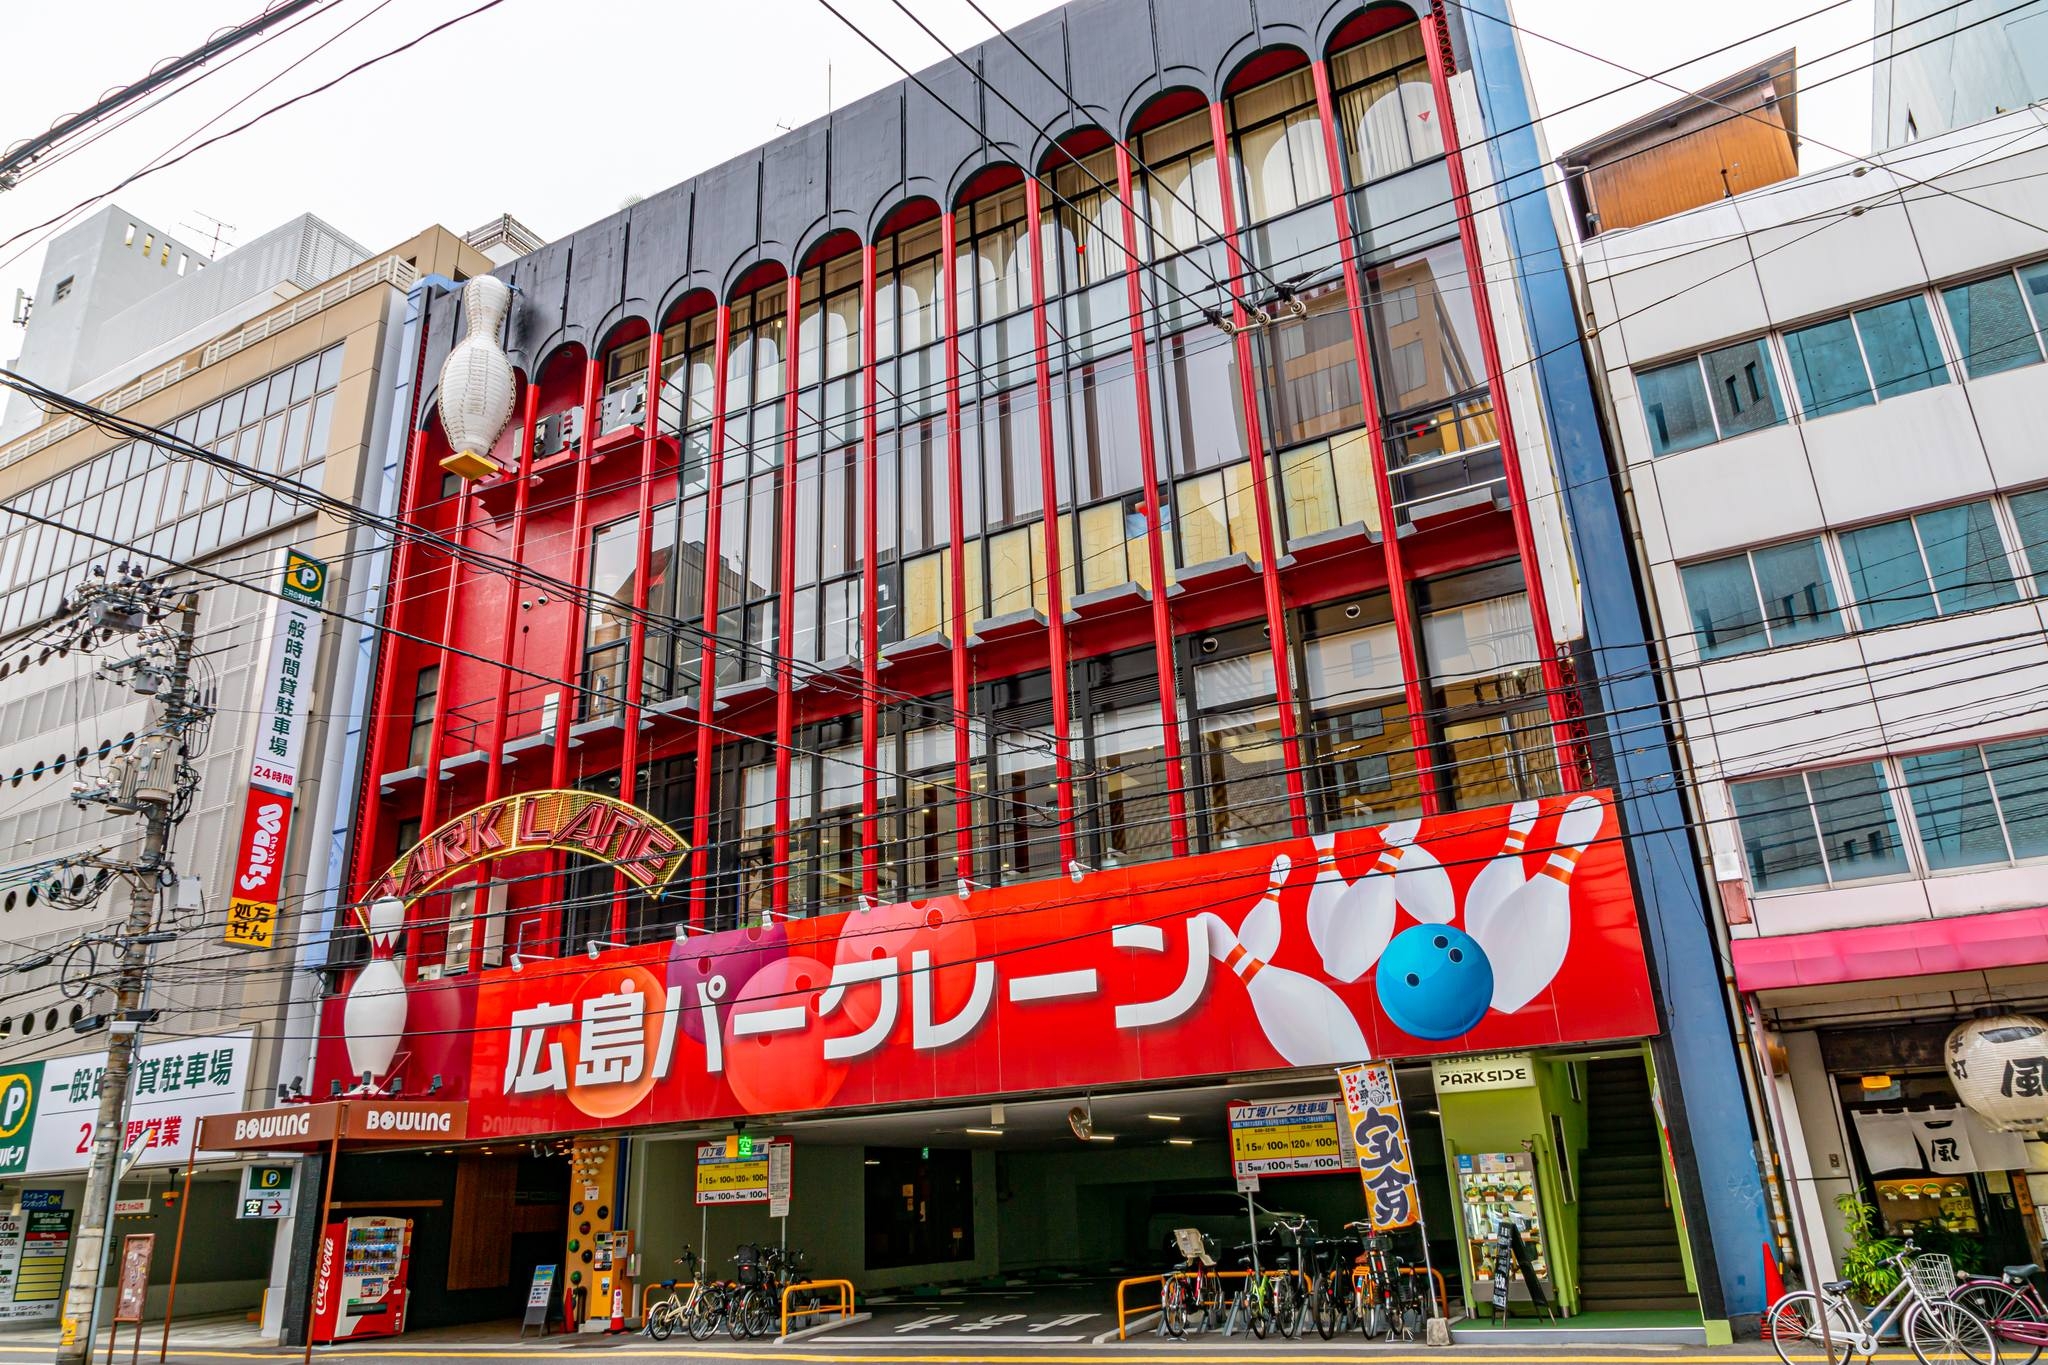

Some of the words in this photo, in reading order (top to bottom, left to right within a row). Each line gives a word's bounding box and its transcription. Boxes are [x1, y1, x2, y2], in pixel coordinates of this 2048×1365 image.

[268, 610, 308, 757] 一般時間貸駐車場
[253, 765, 295, 786] 24時間
[240, 803, 284, 891] Wants
[519, 798, 678, 886] LANE
[233, 902, 271, 923] 処方
[232, 920, 267, 942] せん
[502, 915, 1212, 1096] 広島パークレーン
[50, 1048, 234, 1104] 一般貸駐車場
[75, 1115, 182, 1154] 2間営業
[234, 1112, 310, 1140] BOWLING
[366, 1110, 451, 1132] BOWLING
[738, 1136, 752, 1155] 空
[1923, 1119, 1960, 1163] 一風
[48, 1194, 62, 1205] OK
[244, 1200, 262, 1217] 空
